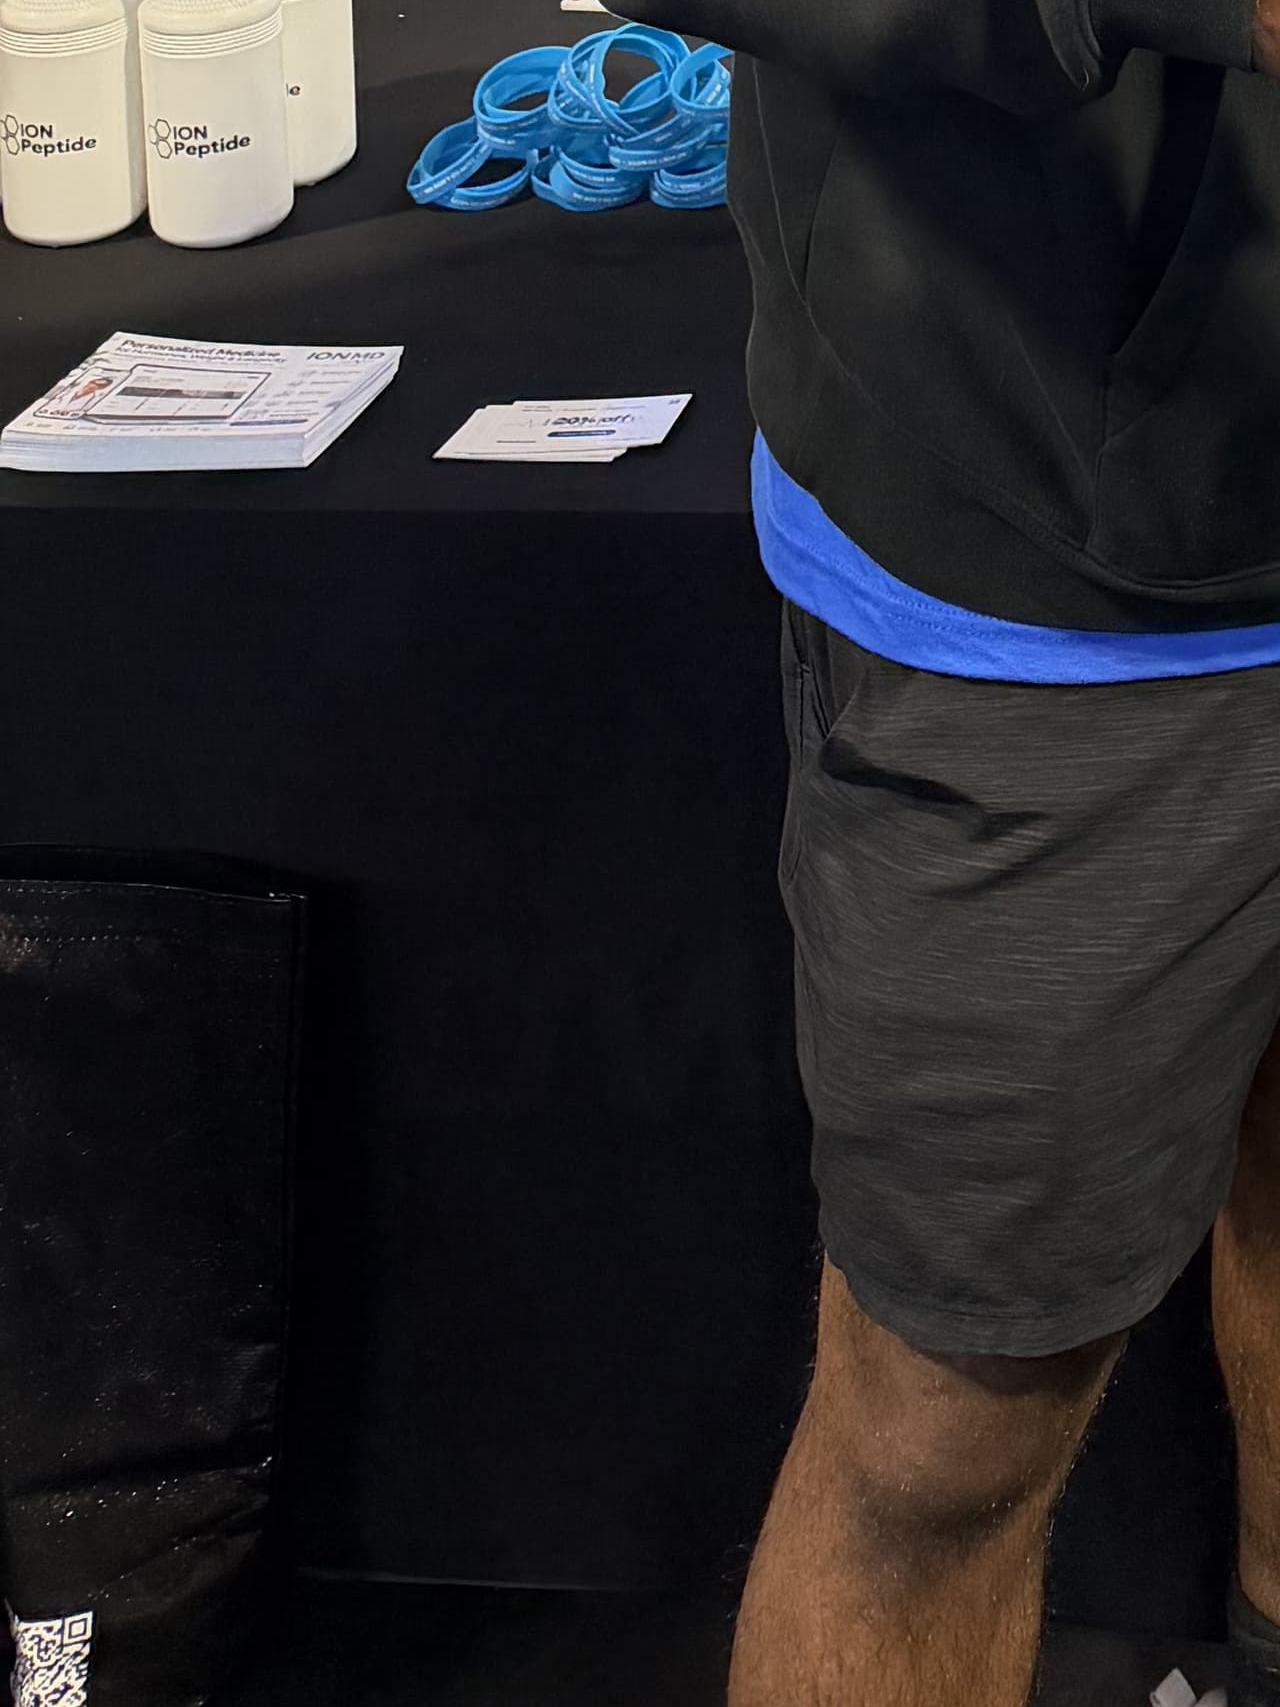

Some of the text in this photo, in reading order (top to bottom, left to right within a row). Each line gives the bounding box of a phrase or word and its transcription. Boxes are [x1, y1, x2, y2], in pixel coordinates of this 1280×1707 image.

[20, 124, 53, 138] ION
[173, 125, 208, 141] ION
[21, 137, 97, 157] Peptide
[174, 135, 251, 159] Peptide
